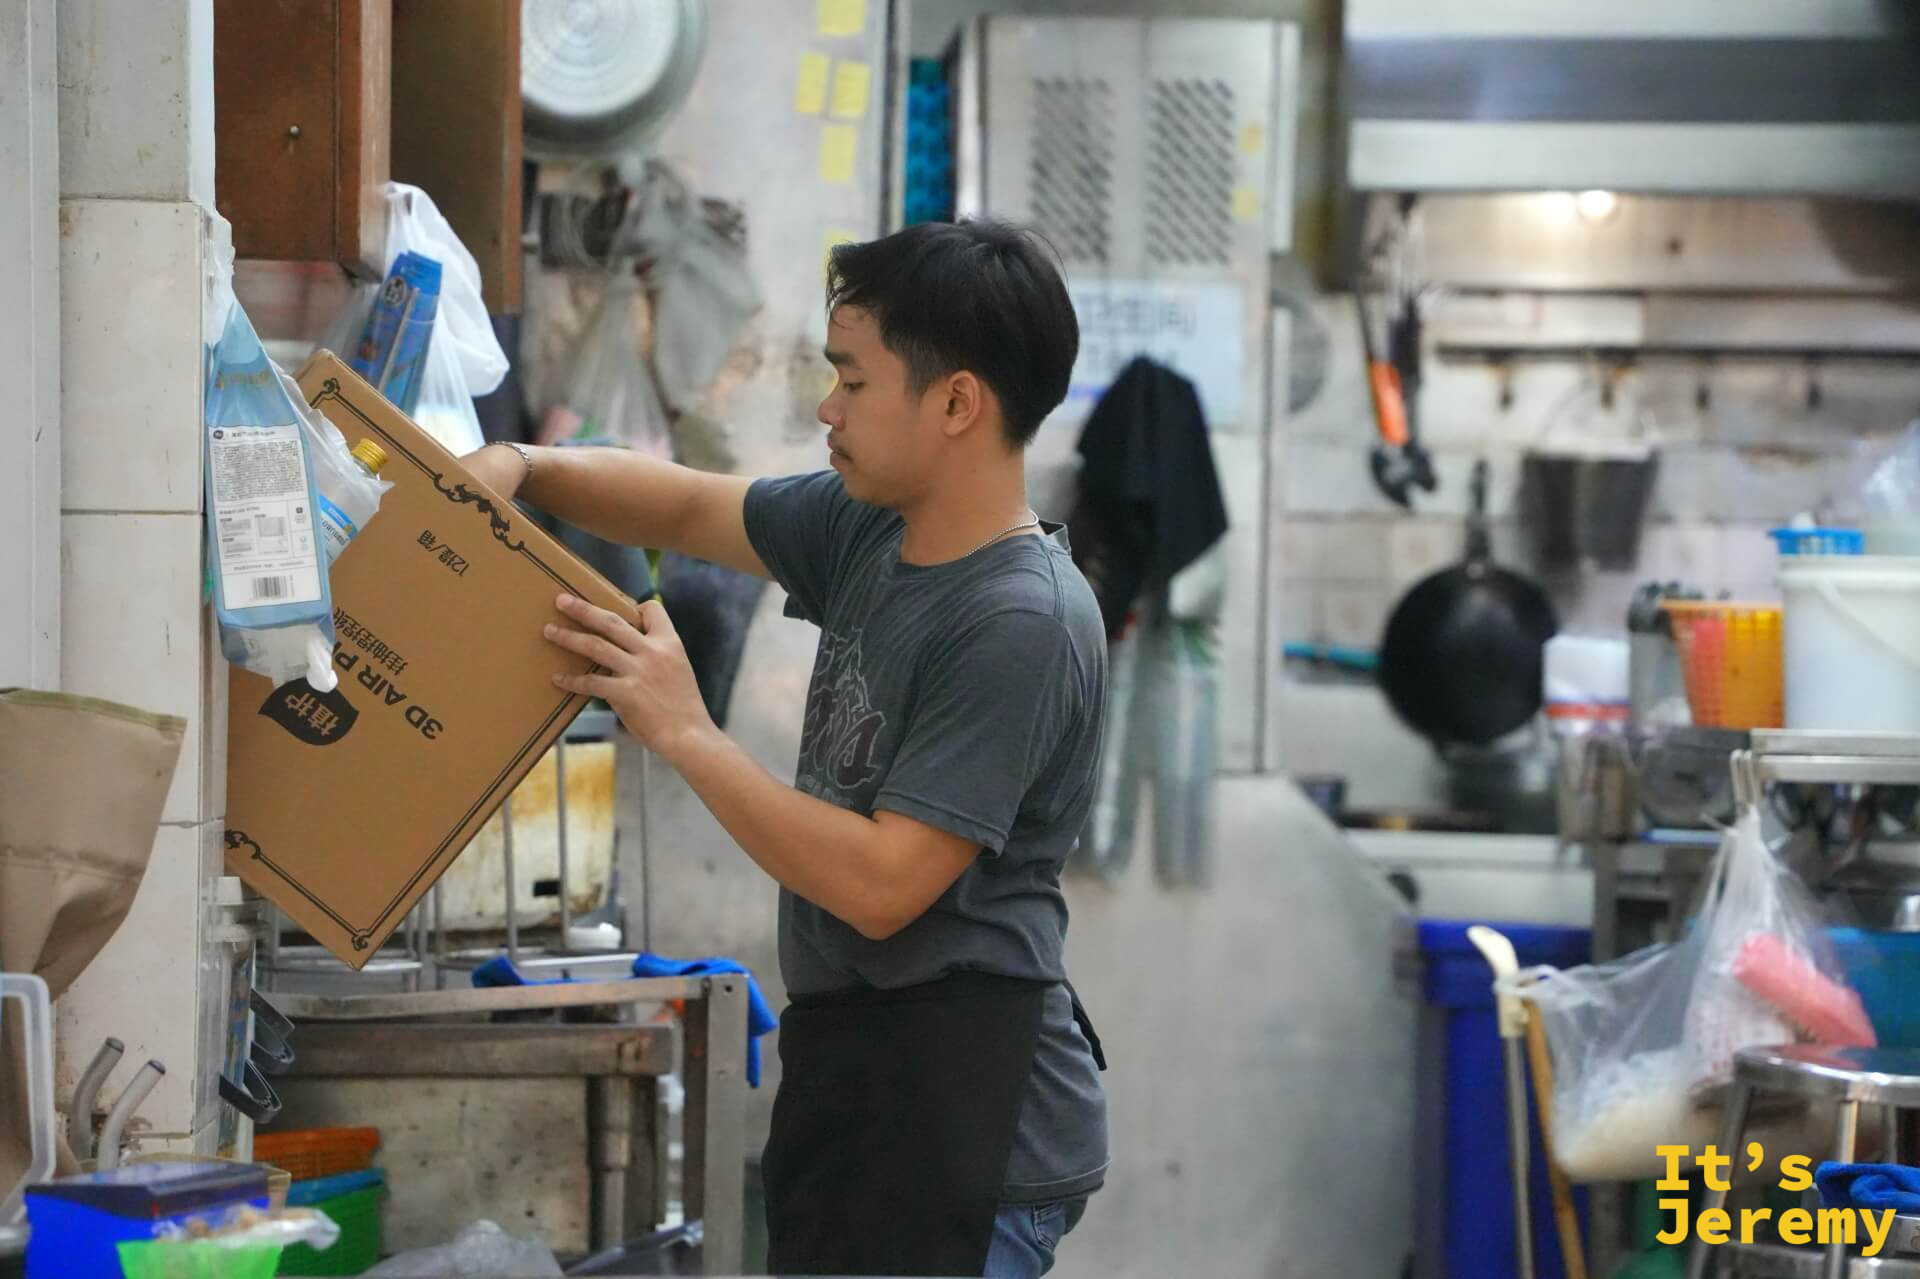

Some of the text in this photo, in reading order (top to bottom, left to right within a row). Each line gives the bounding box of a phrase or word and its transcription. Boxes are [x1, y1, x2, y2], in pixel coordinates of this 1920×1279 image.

[357, 664, 407, 706] AIR
[285, 692, 339, 736] 植护
[405, 705, 443, 740] 3D
